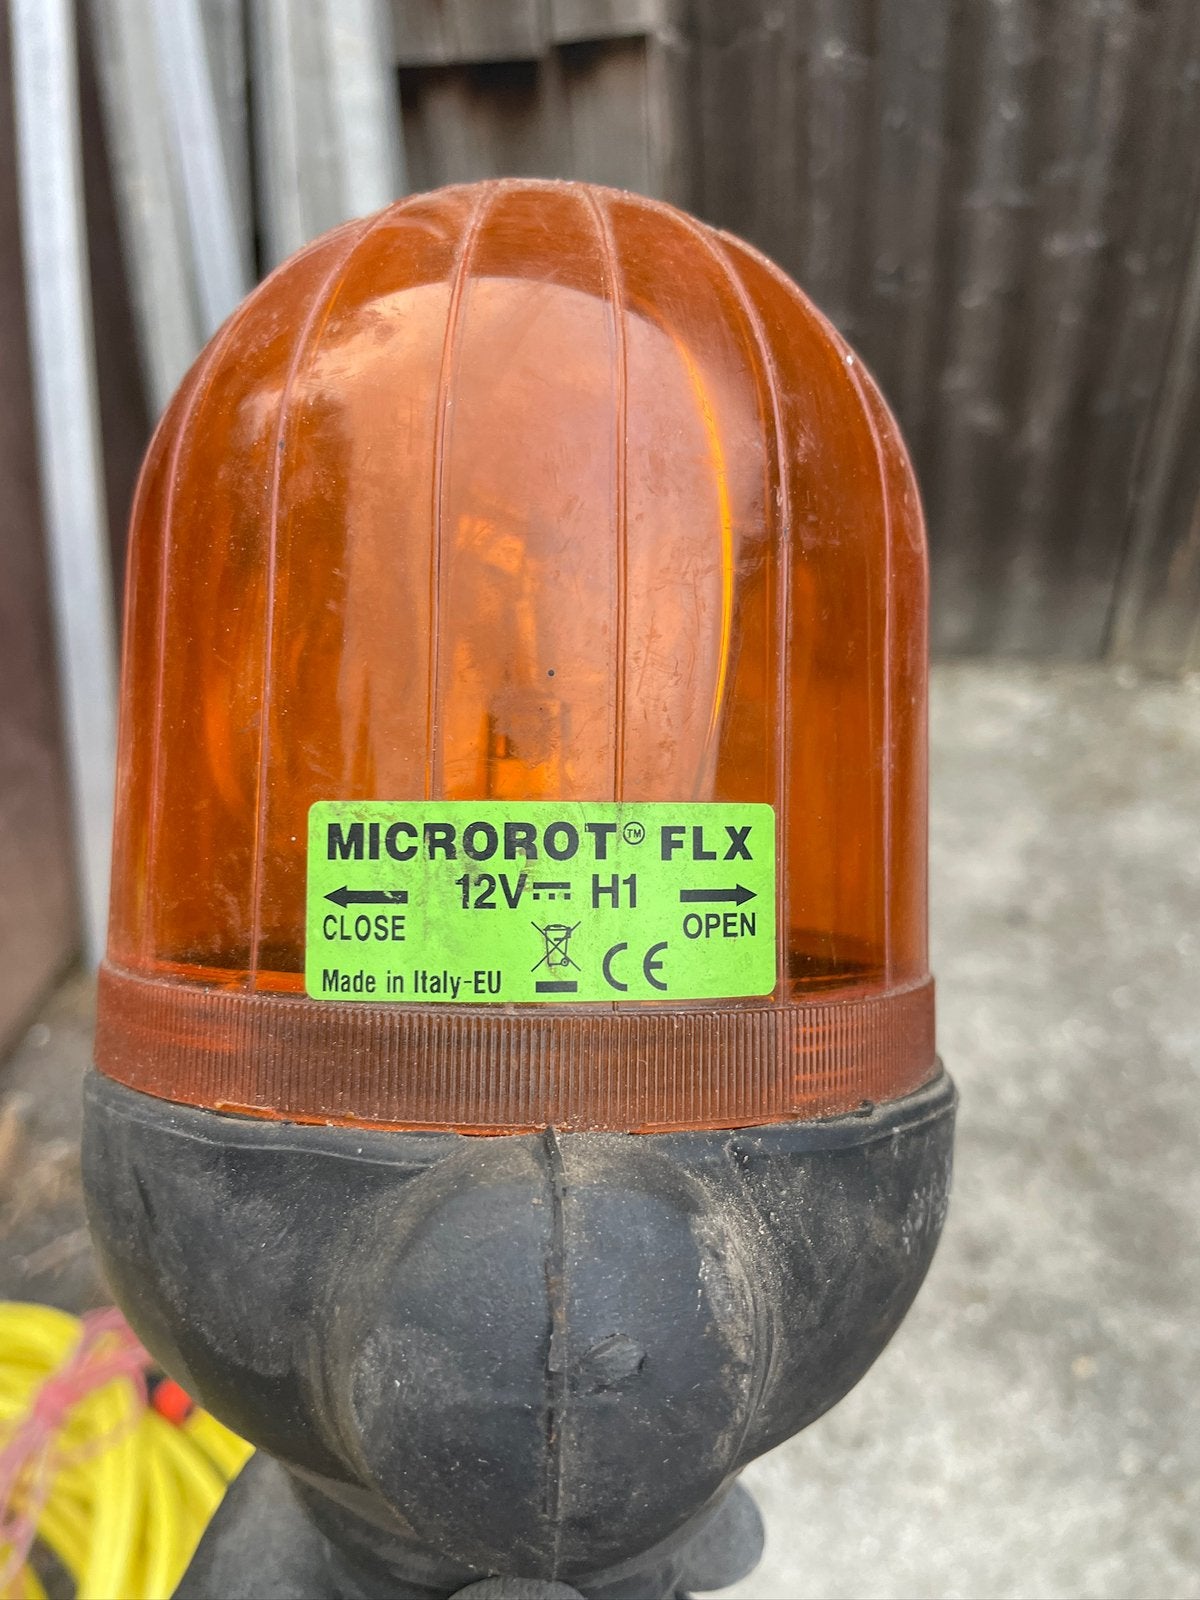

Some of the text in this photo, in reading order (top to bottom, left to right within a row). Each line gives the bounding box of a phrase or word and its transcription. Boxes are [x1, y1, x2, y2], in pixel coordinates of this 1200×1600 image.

[327, 821, 618, 862] MICROROT
[660, 825, 753, 861] FLX
[591, 873, 637, 909] H1
[323, 914, 406, 941] CLOSE
[682, 912, 756, 938] OPEN
[602, 941, 669, 991] CE
[322, 969, 501, 999] Made in Italy-EU
